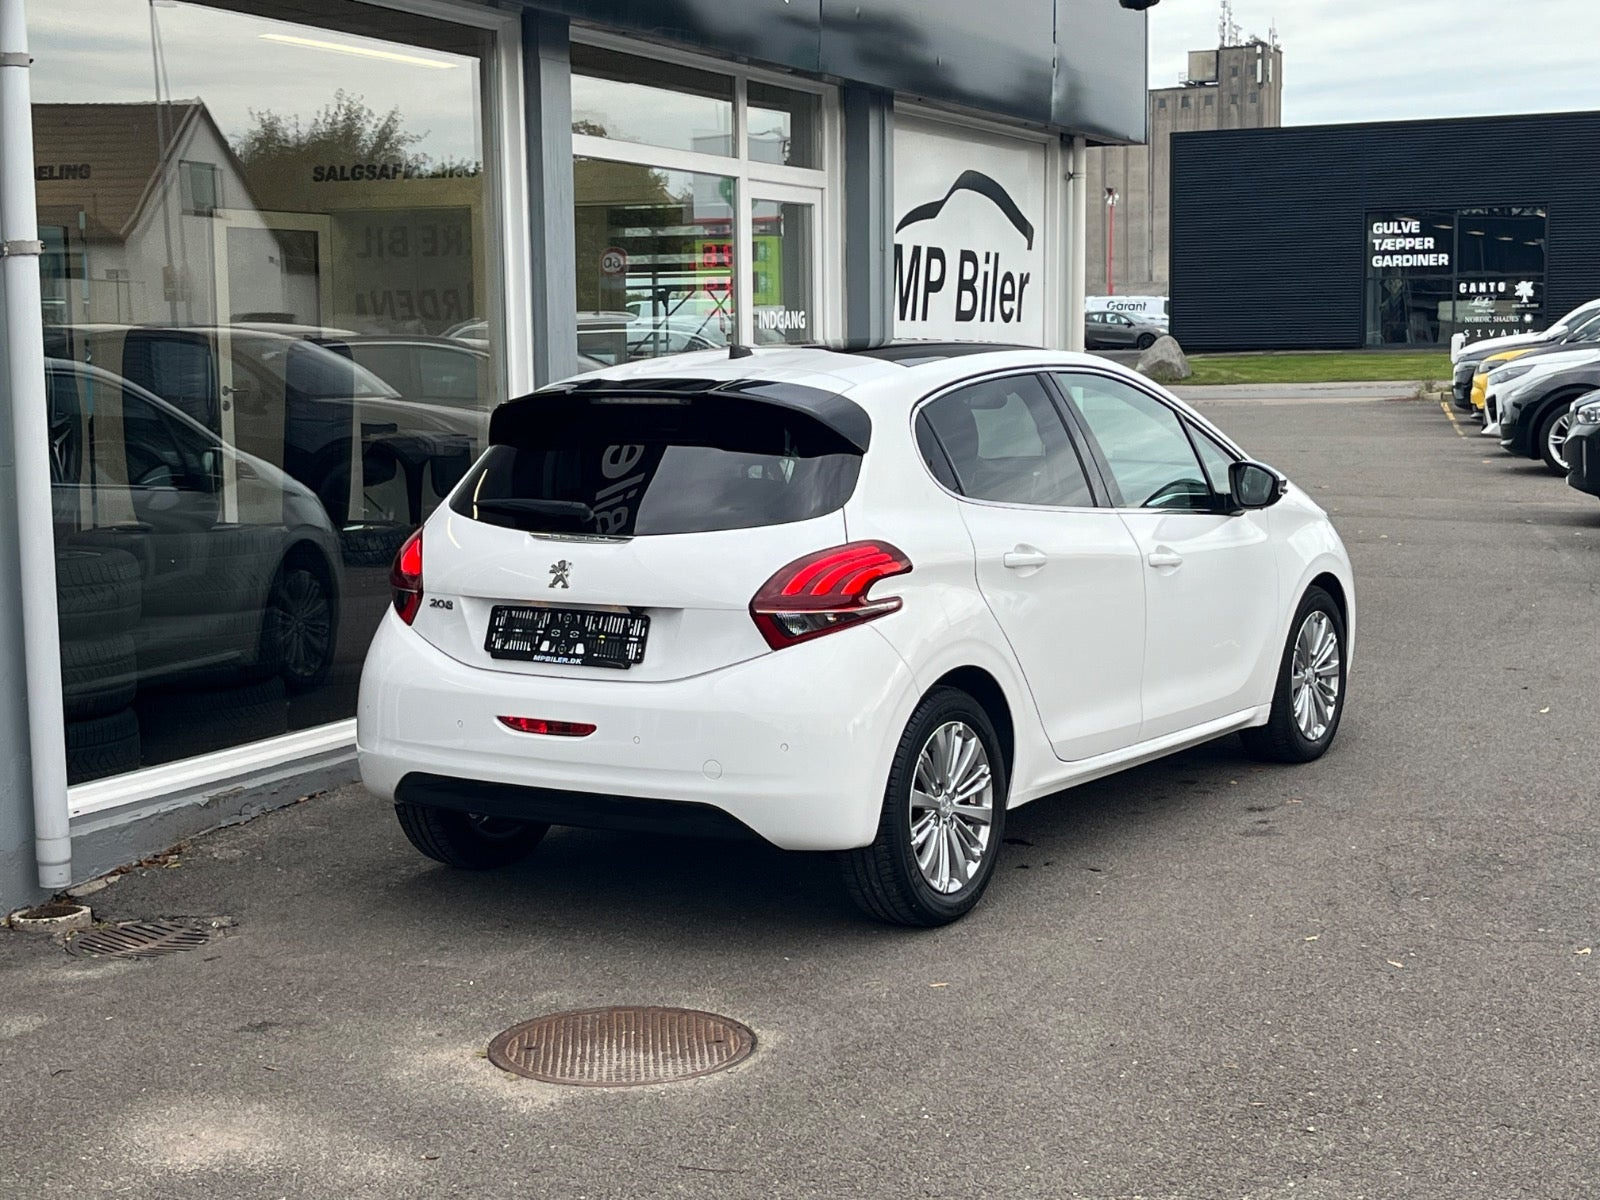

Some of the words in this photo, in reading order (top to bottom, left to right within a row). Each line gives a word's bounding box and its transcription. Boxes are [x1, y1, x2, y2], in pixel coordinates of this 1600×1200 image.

[1372, 221, 1420, 234] GULVE
[1372, 237, 1435, 251] TÆPPER
[1371, 253, 1449, 268] GARDINER
[894, 243, 947, 322] MP
[955, 249, 1031, 324] Biler
[1459, 281, 1506, 294] CANTO
[1106, 300, 1147, 311] Garant
[758, 310, 806, 329] INDGANG
[429, 598, 454, 610] 208
[532, 654, 584, 665] MPBILER.DK
